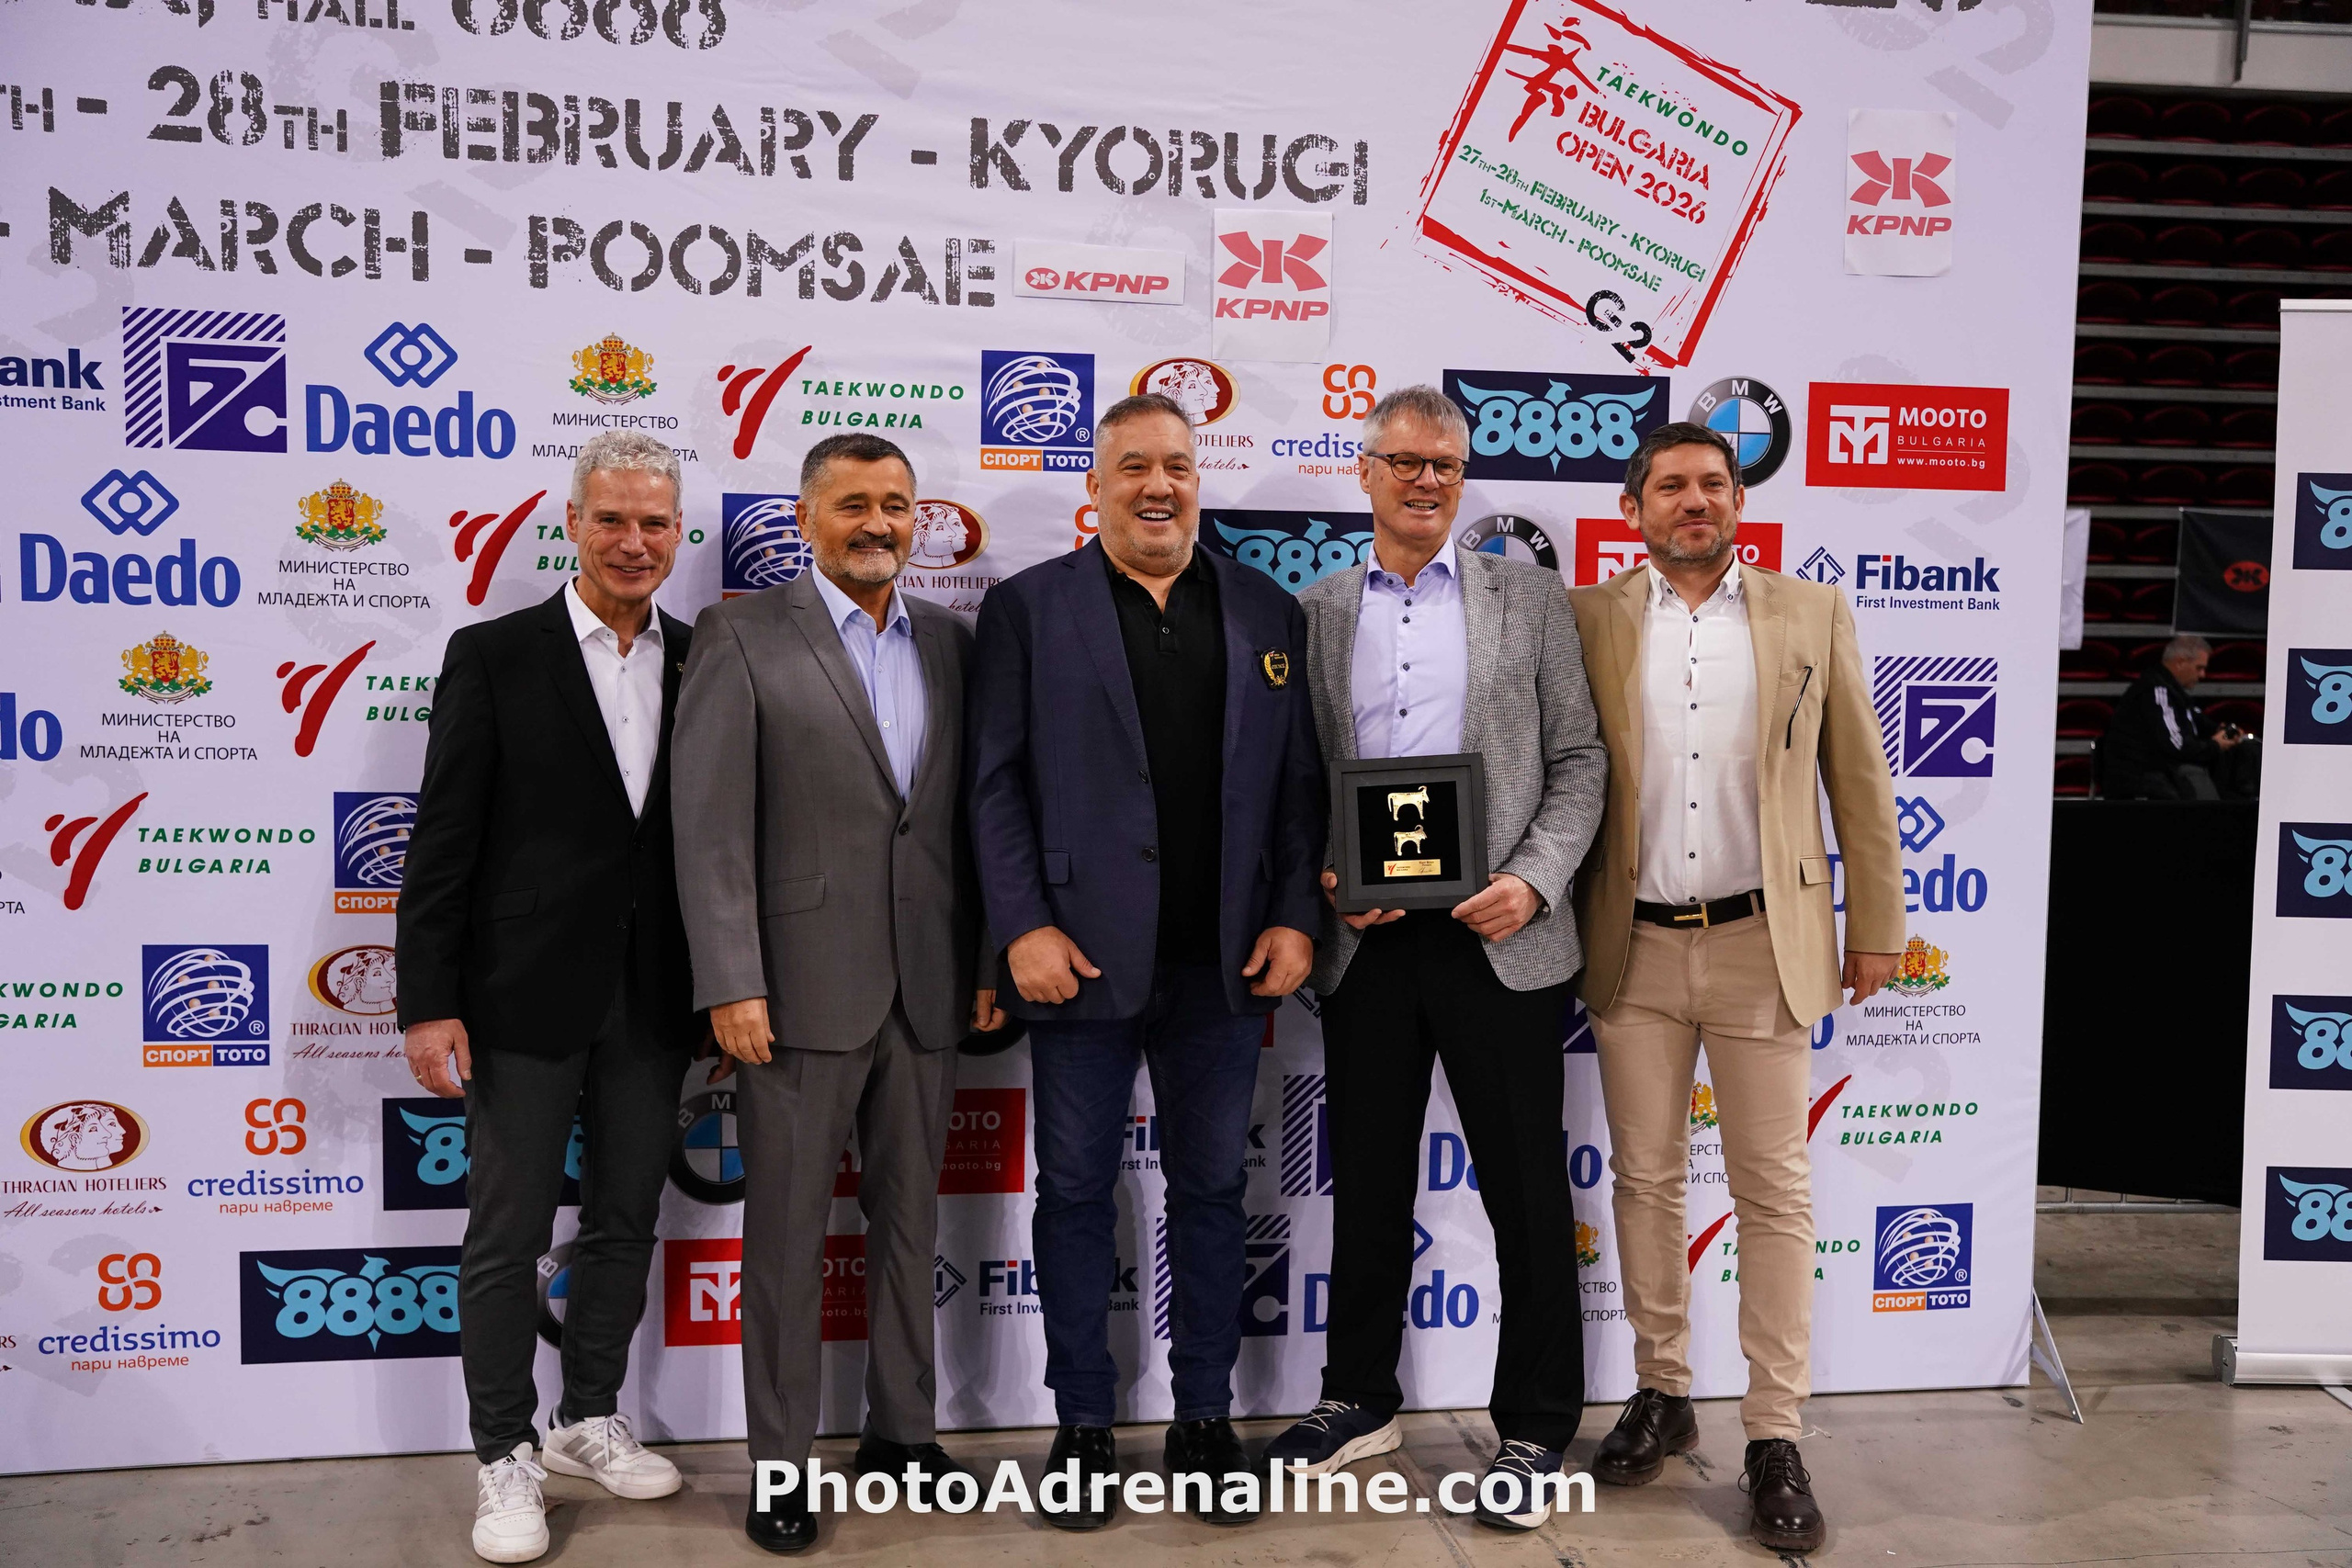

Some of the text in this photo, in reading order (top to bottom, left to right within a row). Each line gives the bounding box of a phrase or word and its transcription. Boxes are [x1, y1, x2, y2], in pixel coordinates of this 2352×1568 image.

[1596, 66, 1748, 156] TAEKWONDO
[146, 65, 348, 152] 28TH
[379, 81, 879, 182] FEBRUARY
[968, 117, 1369, 206] KYORUGI
[1577, 100, 1709, 191] BULGARIA
[1556, 130, 1707, 224] OPEN 2026
[1529, 180, 1621, 237] FEBRUARY
[1630, 232, 1706, 283] KYORUGI
[1847, 214, 1952, 237] KPNP
[48, 186, 430, 282] MARCH
[526, 214, 996, 307] POOMSAE
[1577, 237, 1662, 293] POOMSAE
[1064, 272, 1169, 295] KPNP
[1215, 297, 1329, 321] KPNP
[802, 379, 965, 400] TAEKWONDO
[1697, 379, 1784, 416] BMW
[62, 395, 106, 412] Bank
[306, 384, 516, 459] Daedo
[552, 412, 679, 430] МИНИСТЕРСТВО
[801, 410, 923, 429] BULGARIA
[1897, 406, 1987, 429] MOOTO
[1470, 399, 1640, 460] 8888
[1897, 435, 1986, 448] BULGARIA
[982, 452, 1091, 468] СПОРТ ТОТО
[1195, 456, 1237, 470] hotels
[1896, 456, 1986, 470] www.mooto.bg
[1298, 463, 1332, 478] пари
[1460, 516, 1550, 550] BMW
[19, 533, 241, 607] Daedo
[278, 559, 410, 576] МИНИСТЕРСТВО
[1856, 554, 2000, 592] Fibank
[334, 578, 356, 591] НА
[258, 592, 431, 610] МЛАДЕЖТА И СПОРТА
[1856, 596, 2000, 611] First Investment Bank
[101, 713, 236, 728] МИНИСТЕРСТВО
[158, 730, 181, 743] НА
[80, 745, 257, 762] МЛАДЕЖТА И СПОРТА
[138, 828, 316, 843] TAEKWONDO
[138, 859, 272, 874] BULGARIA
[1863, 1005, 1966, 1018] МИНИСТЕРСТВО
[289, 1021, 362, 1036] THRACIAN
[1905, 1020, 1923, 1032] НА
[1846, 1032, 1981, 1047] МЛАДЕЖТА И СПОРТА
[146, 1047, 266, 1064] СПОРТ ТОТО
[292, 1042, 329, 1059] All
[327, 1049, 379, 1059] seasons
[1841, 1102, 1979, 1119] TAEKWONDO
[1840, 1130, 1943, 1145] BULGARIA
[1, 1177, 167, 1194] THRACIAN HOTELIERS
[187, 1168, 364, 1198] credissimo
[4, 1201, 147, 1218] All seasons hotels
[219, 1197, 334, 1214] пари навреме
[980, 1303, 1012, 1315] First
[1874, 1292, 1968, 1310] СПОРТ ТОТО
[39, 1324, 221, 1356] credissimo
[71, 1354, 189, 1373] пари навреме
